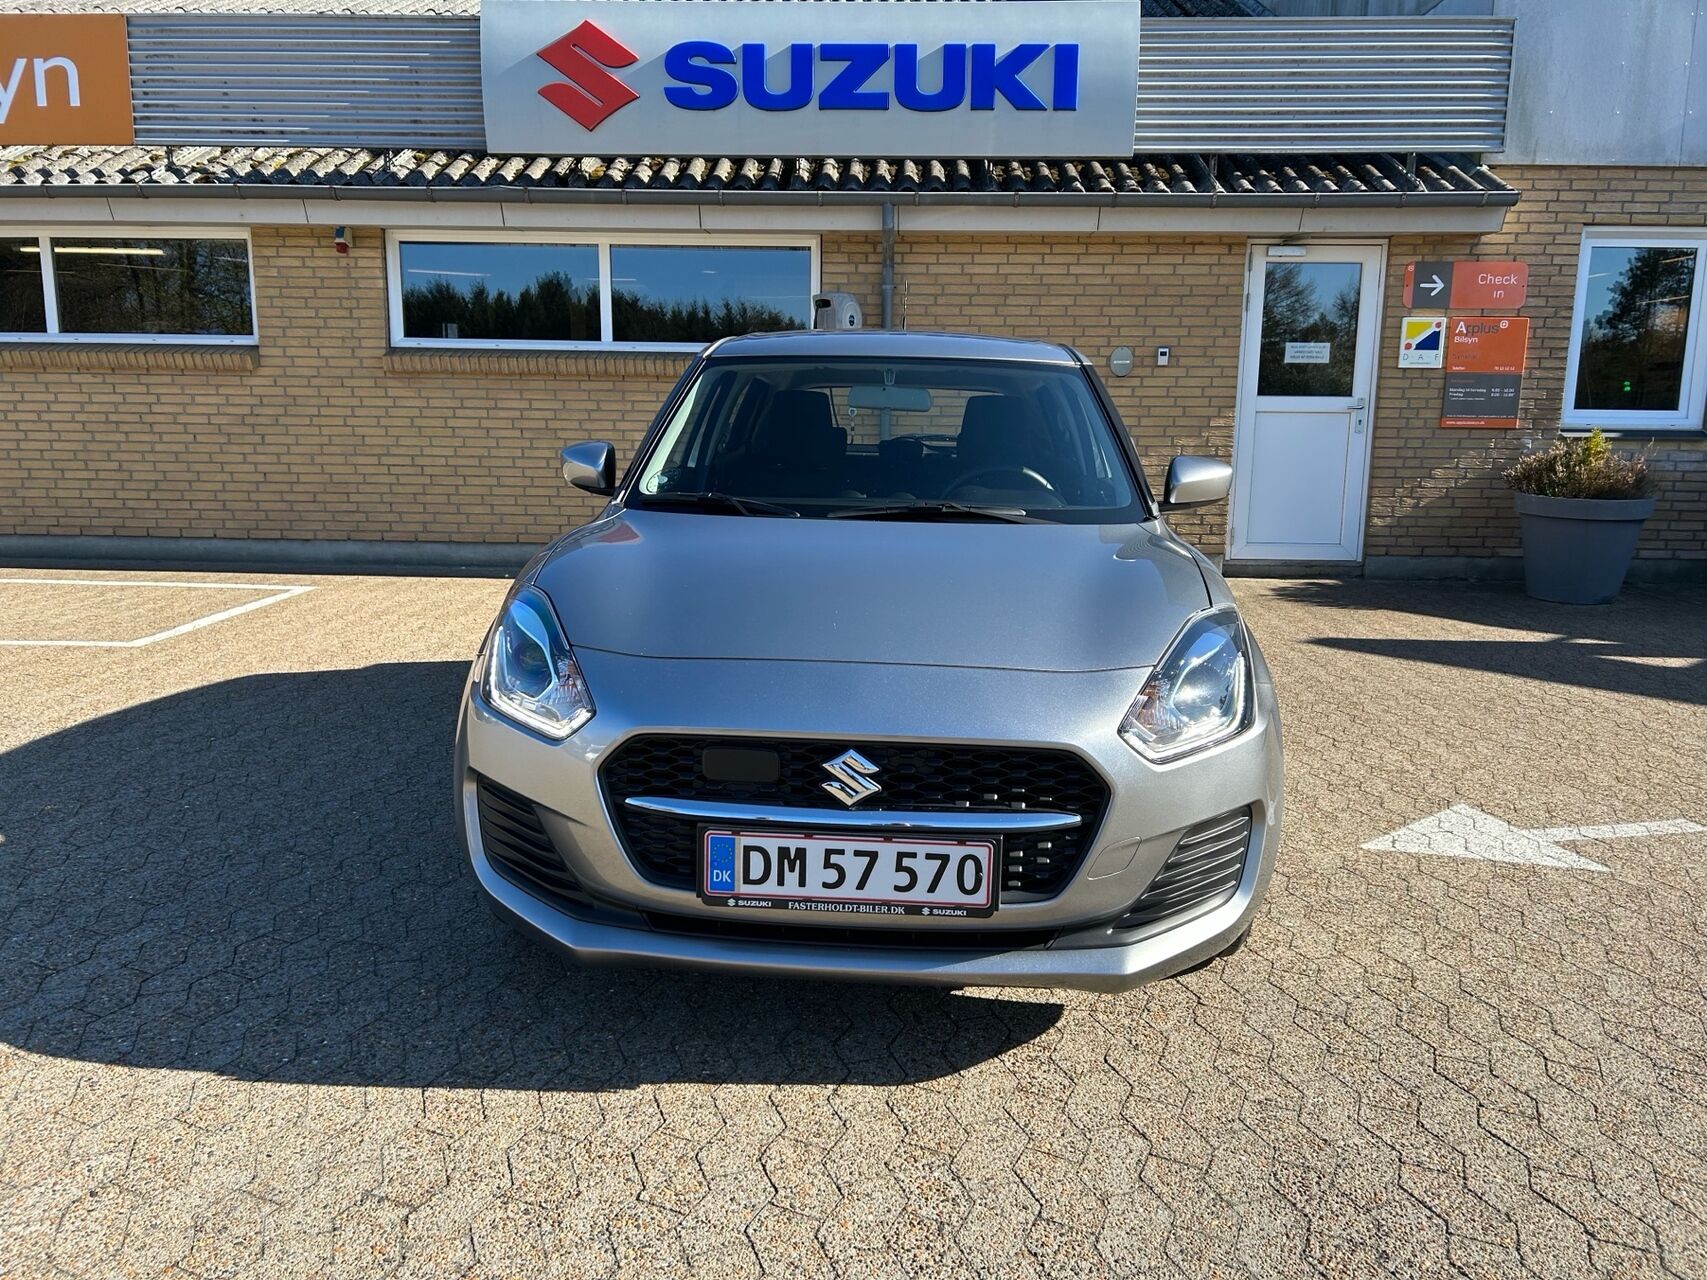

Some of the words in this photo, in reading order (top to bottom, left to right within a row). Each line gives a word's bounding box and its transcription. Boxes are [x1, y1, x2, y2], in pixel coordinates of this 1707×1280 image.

[663, 41, 1079, 111] SUZUKI
[1478, 273, 1519, 285] Check
[1493, 290, 1504, 299] in
[713, 869, 732, 883] DK
[742, 845, 807, 888] DM
[821, 848, 879, 890] 57
[893, 851, 984, 896] 570
[737, 899, 772, 907] SUZUKI
[788, 901, 906, 915] FASTERHOLDT-BILER.DK
[932, 908, 968, 916] SUZUKI
